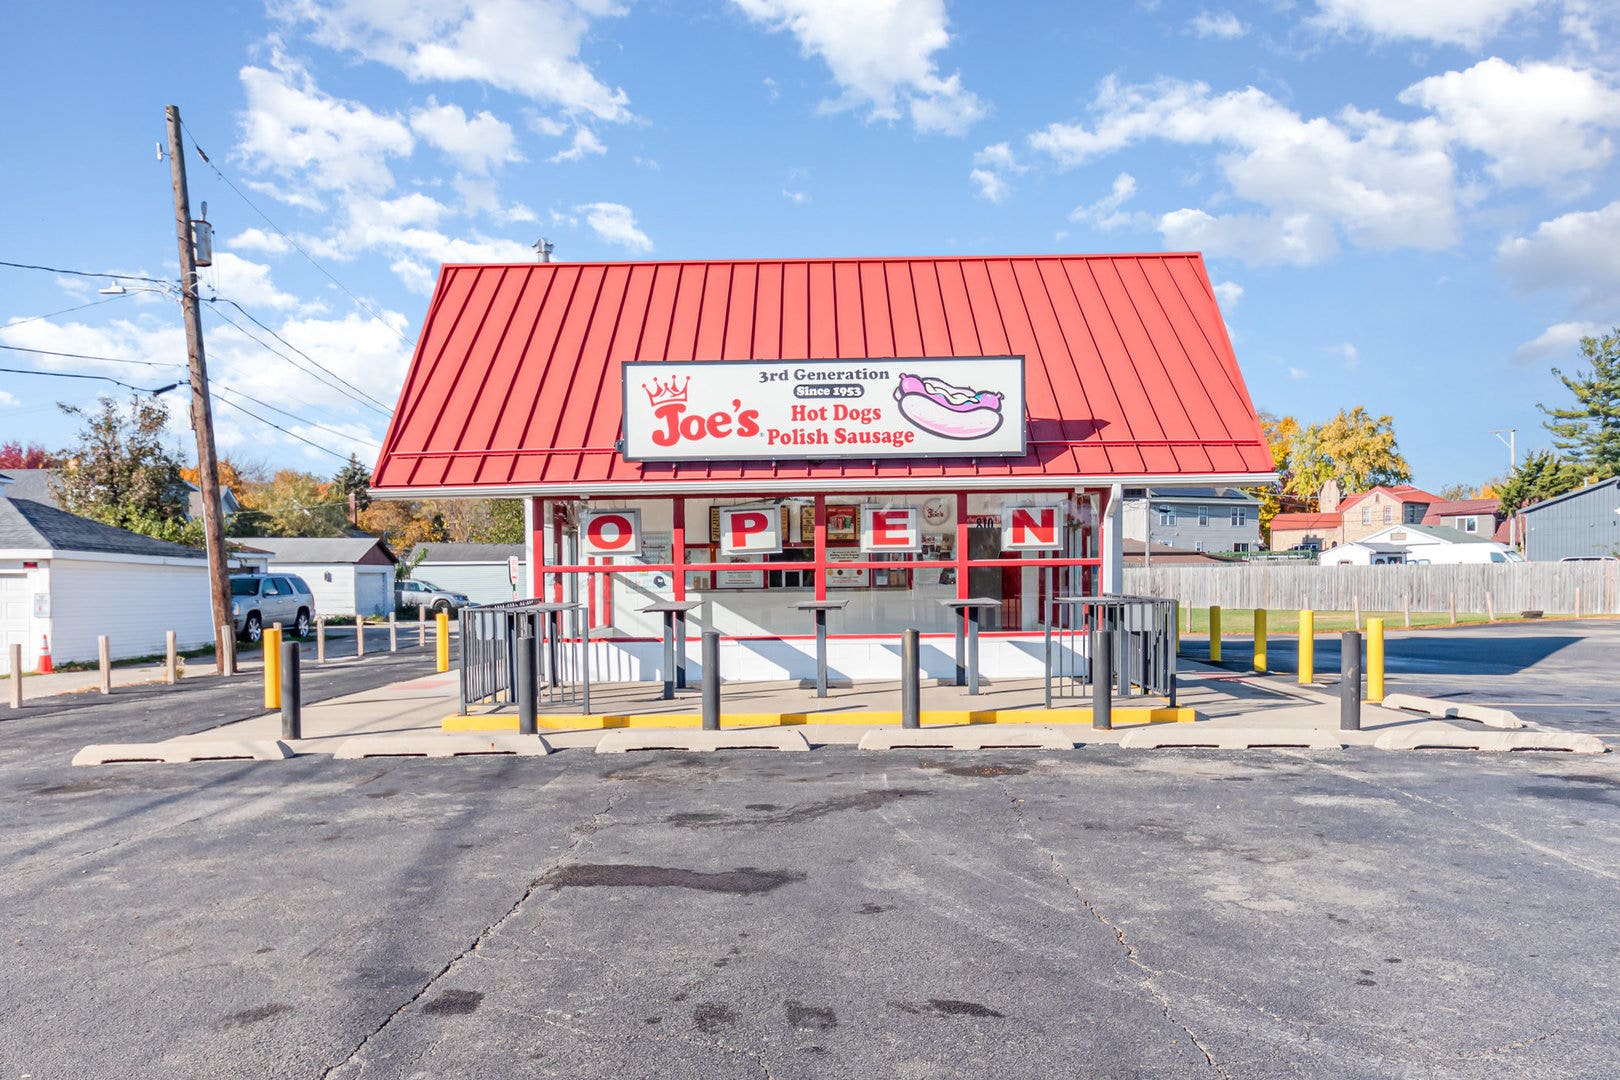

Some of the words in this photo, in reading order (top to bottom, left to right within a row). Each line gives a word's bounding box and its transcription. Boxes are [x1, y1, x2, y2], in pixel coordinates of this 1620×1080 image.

[758, 369, 788, 384] 3rd
[793, 367, 890, 381] Generation
[796, 385, 830, 397] Since
[833, 385, 862, 397] 1953
[651, 399, 759, 447] Joe's
[791, 405, 828, 421] Hot
[833, 404, 881, 424] Dogs
[767, 428, 829, 445] Polish
[834, 428, 915, 448] Sausage
